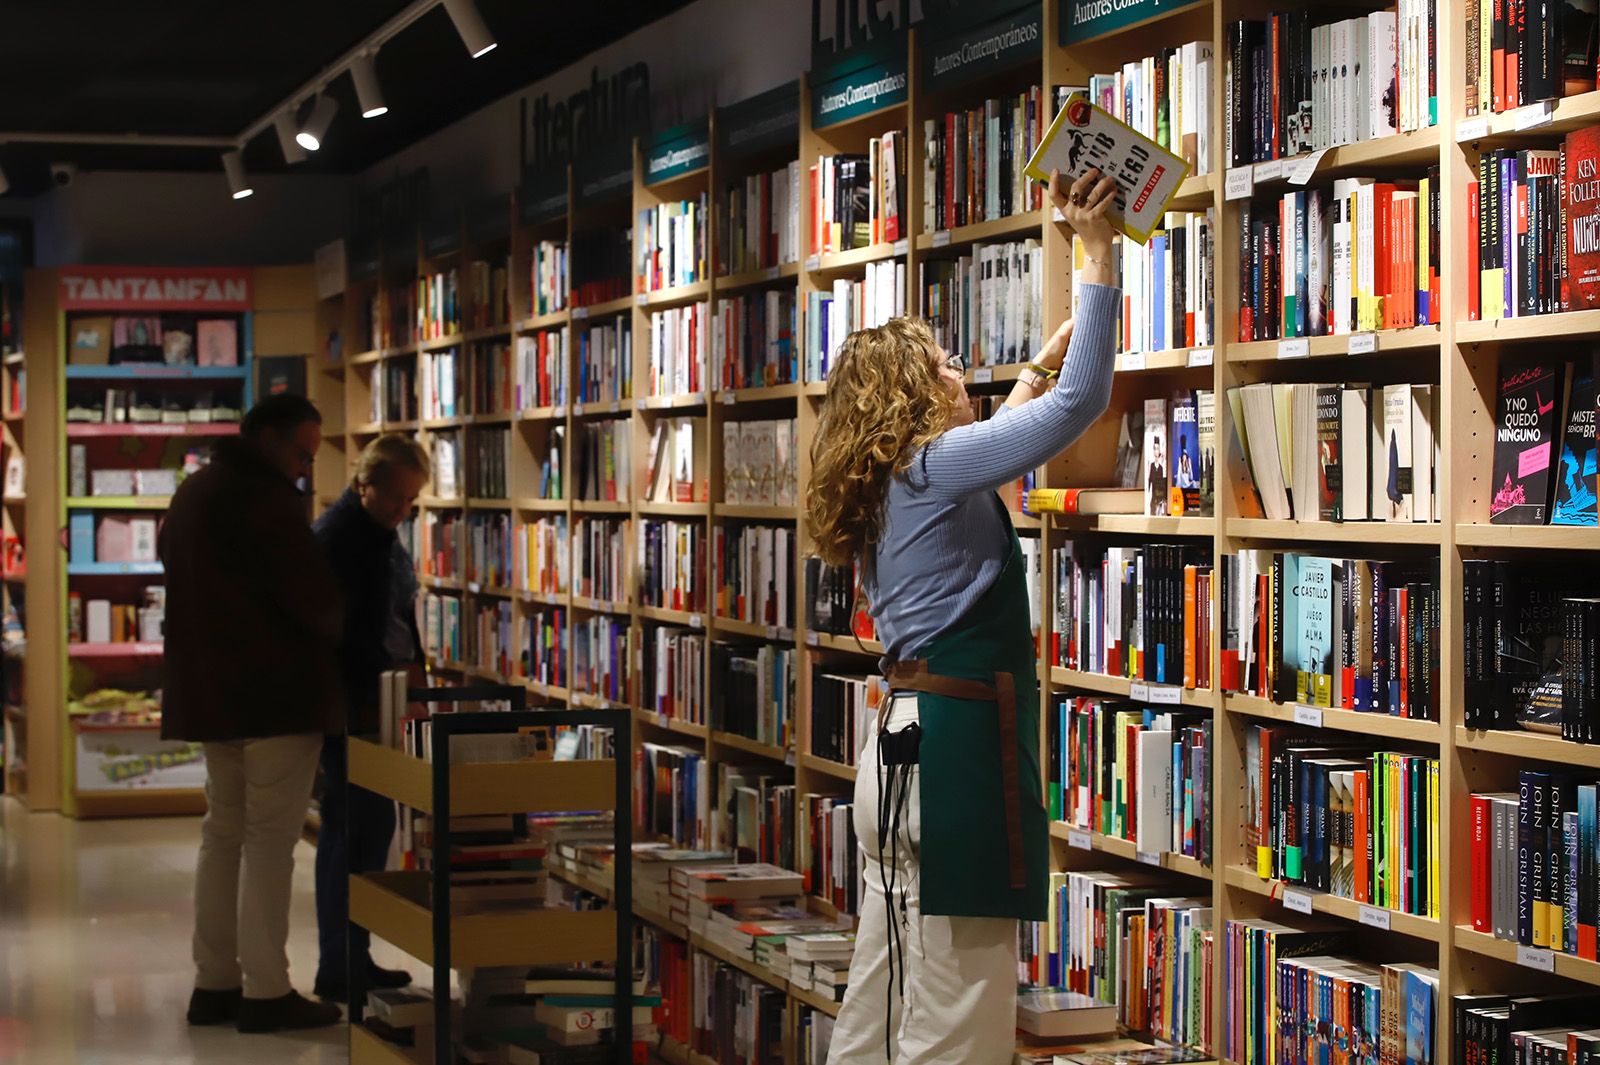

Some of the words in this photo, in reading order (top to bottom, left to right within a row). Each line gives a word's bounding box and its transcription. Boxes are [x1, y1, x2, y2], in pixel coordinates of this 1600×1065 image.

[1073, 0, 1112, 25] Autores
[933, 51, 962, 76] Autores
[961, 21, 1038, 65] Contemporáneos
[821, 91, 846, 114] Autores
[846, 71, 906, 106] Contemporáneos
[1108, 161, 1118, 172] DE
[1577, 159, 1597, 179] KEN
[1135, 188, 1150, 210] PABLO
[1297, 240, 1303, 249] DE
[1481, 238, 1487, 247] LA
[1491, 237, 1497, 245] LA
[1561, 270, 1567, 278] UN
[61, 276, 247, 303] TANTANFAN
[1505, 398, 1513, 411] Y
[1513, 397, 1527, 411] NO
[1317, 407, 1338, 418] DONDO
[1505, 409, 1539, 429] QUEDÓ
[1497, 428, 1541, 442] NINGUNO
[1567, 423, 1584, 433] SEÑOR
[1304, 571, 1324, 584] JAVIER
[1301, 586, 1328, 600] CASTILLO
[1306, 610, 1322, 621] JUEGO
[1519, 621, 1542, 634] LAS
[1305, 629, 1323, 642] ALMA
[1373, 662, 1376, 670] DE
[1375, 661, 1379, 670] LA
[1520, 781, 1528, 824] JOHN
[1534, 784, 1542, 828] JOHN
[1551, 785, 1559, 829] JOHN
[1534, 852, 1542, 900] GRISH
